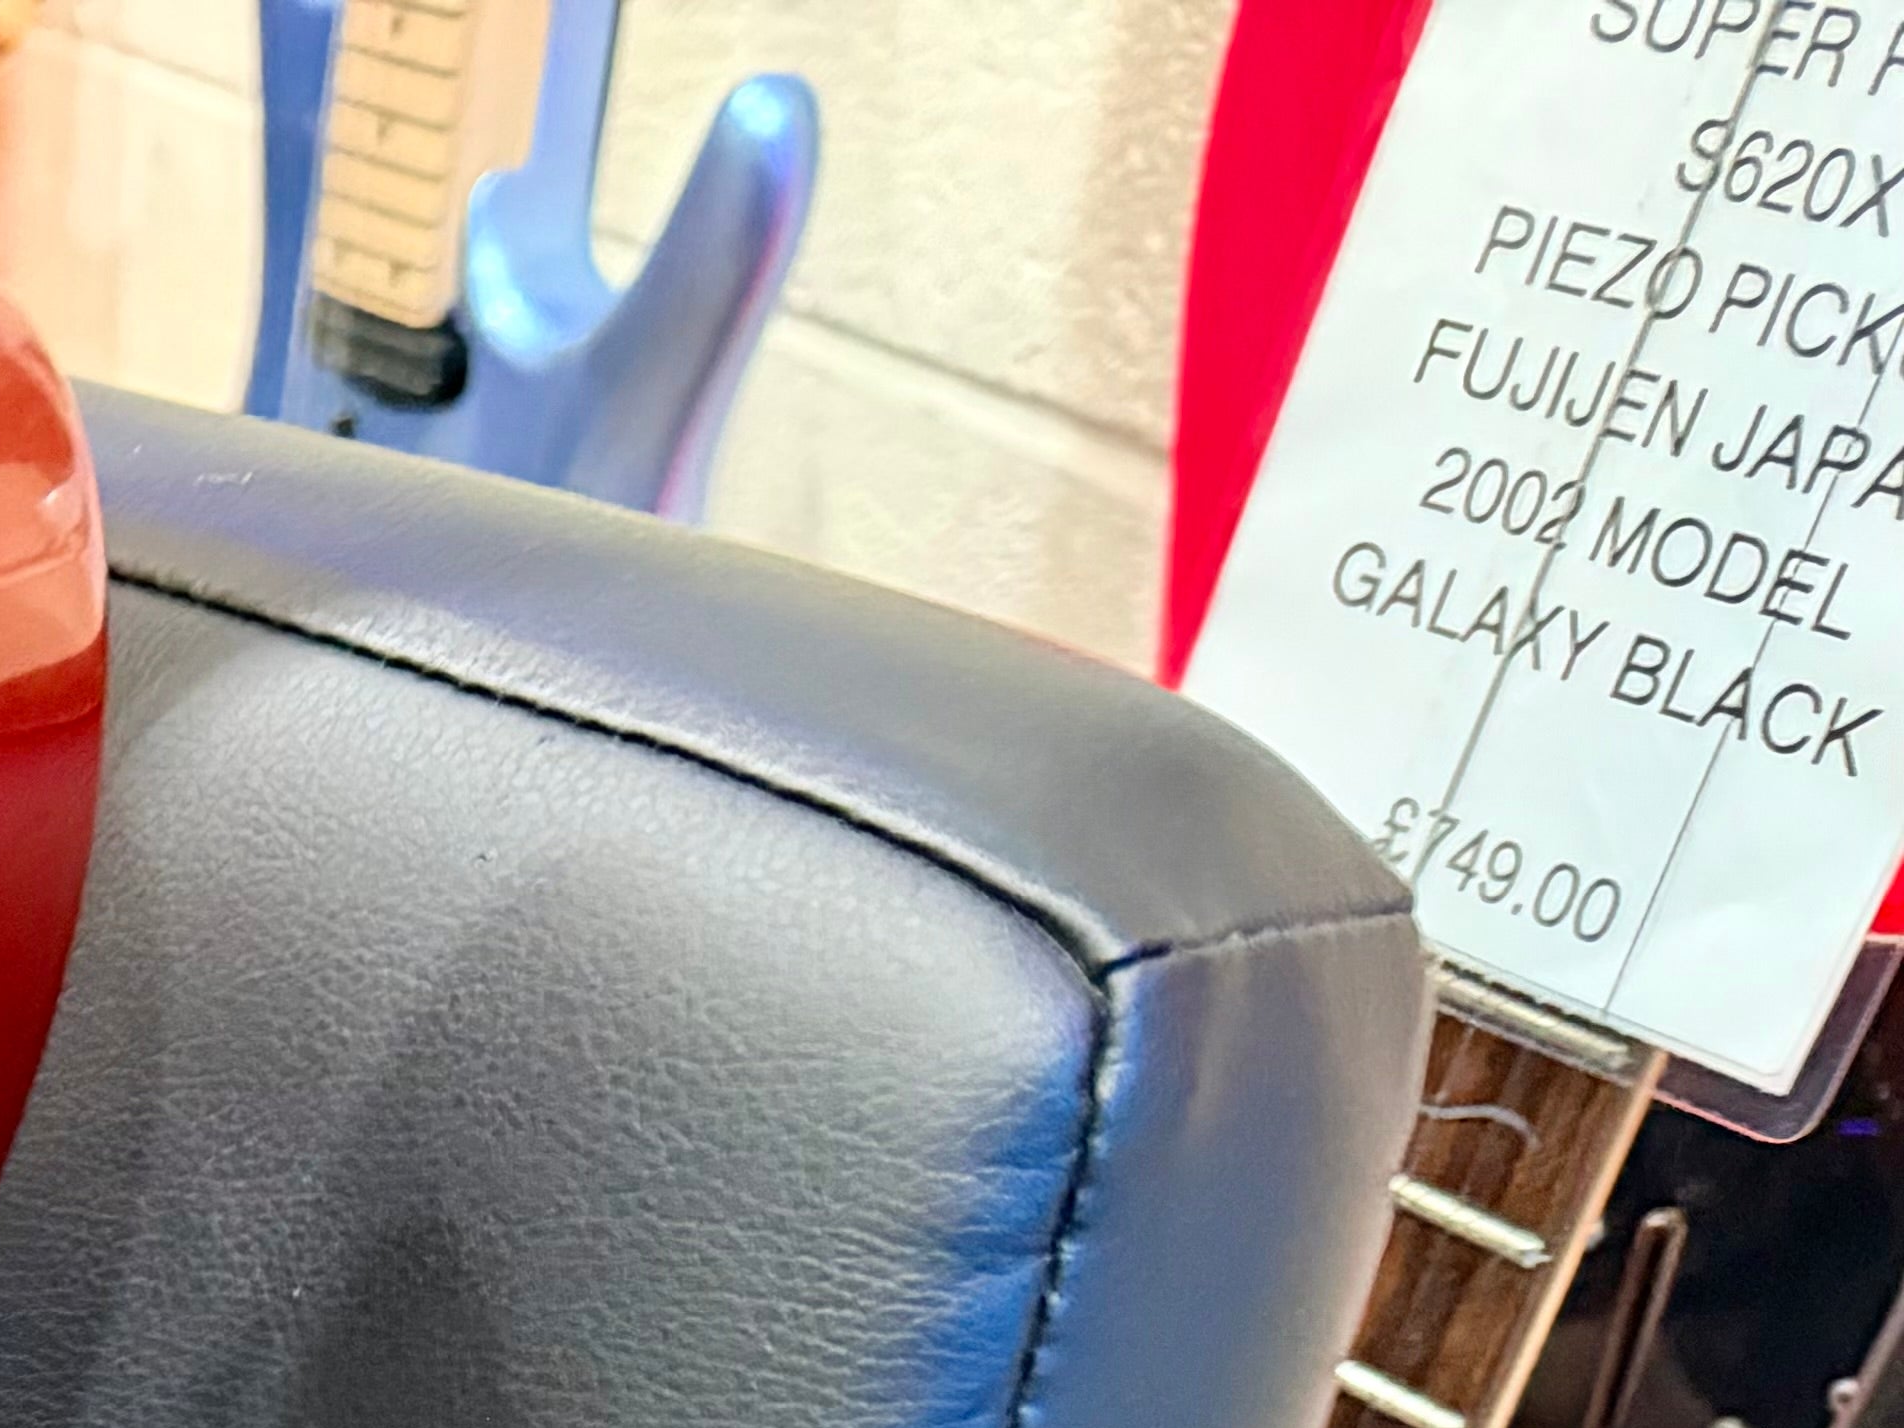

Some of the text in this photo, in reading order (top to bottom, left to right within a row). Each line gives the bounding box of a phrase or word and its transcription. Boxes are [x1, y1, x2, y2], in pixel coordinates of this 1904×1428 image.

[1676, 119, 1904, 237] S620X
[1474, 205, 1904, 381] PIEZO PICK
[1413, 318, 1708, 457] FUJIJEN
[1419, 447, 1852, 640] 2002 MODEL
[1333, 542, 1884, 776] GALAXY BLACK
[1373, 798, 1622, 942] £749.00
